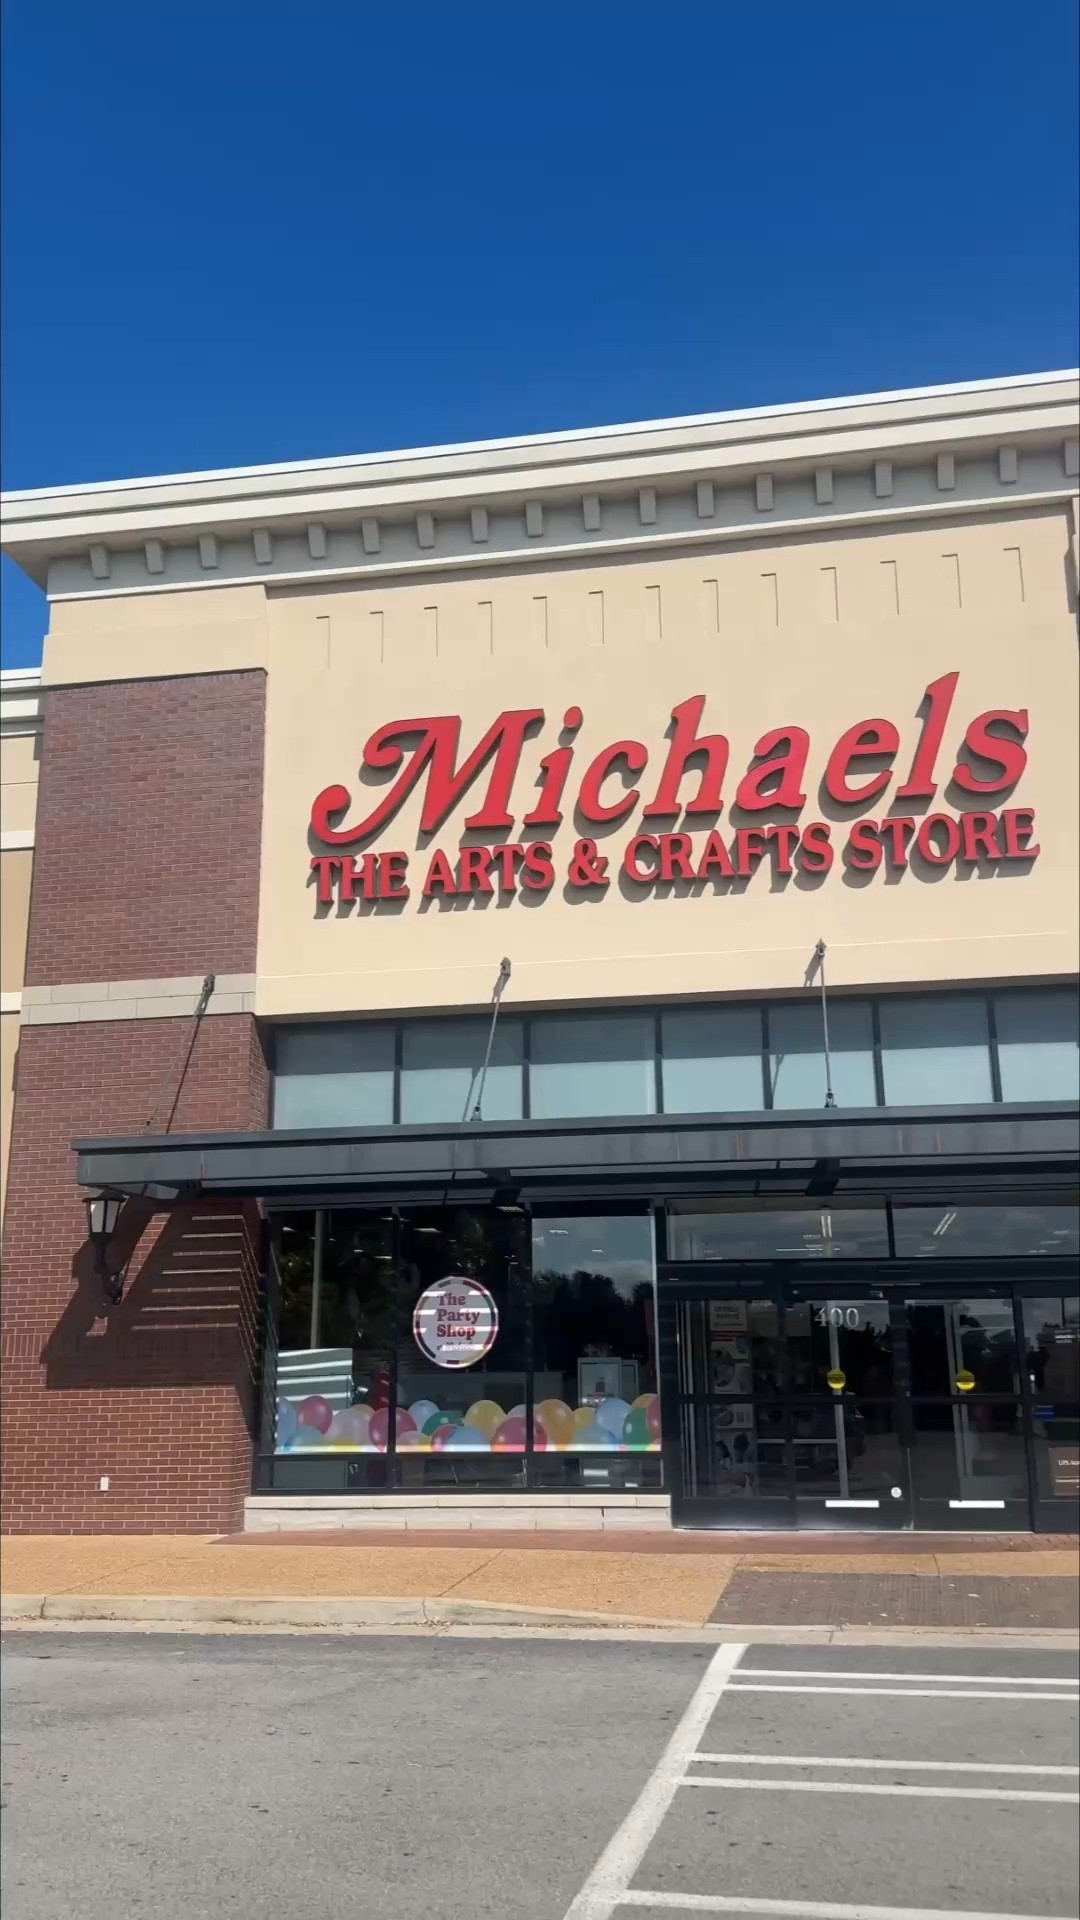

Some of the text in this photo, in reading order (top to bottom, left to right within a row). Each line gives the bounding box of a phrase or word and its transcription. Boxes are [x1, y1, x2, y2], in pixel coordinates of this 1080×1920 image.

[310, 671, 1029, 844] Michaels
[310, 807, 1040, 902] THE ARTS & CRAFTS STORE
[437, 1292, 467, 1306] The
[436, 1309, 480, 1325] Party
[814, 1306, 860, 1328] 400
[436, 1324, 476, 1341] Shop
